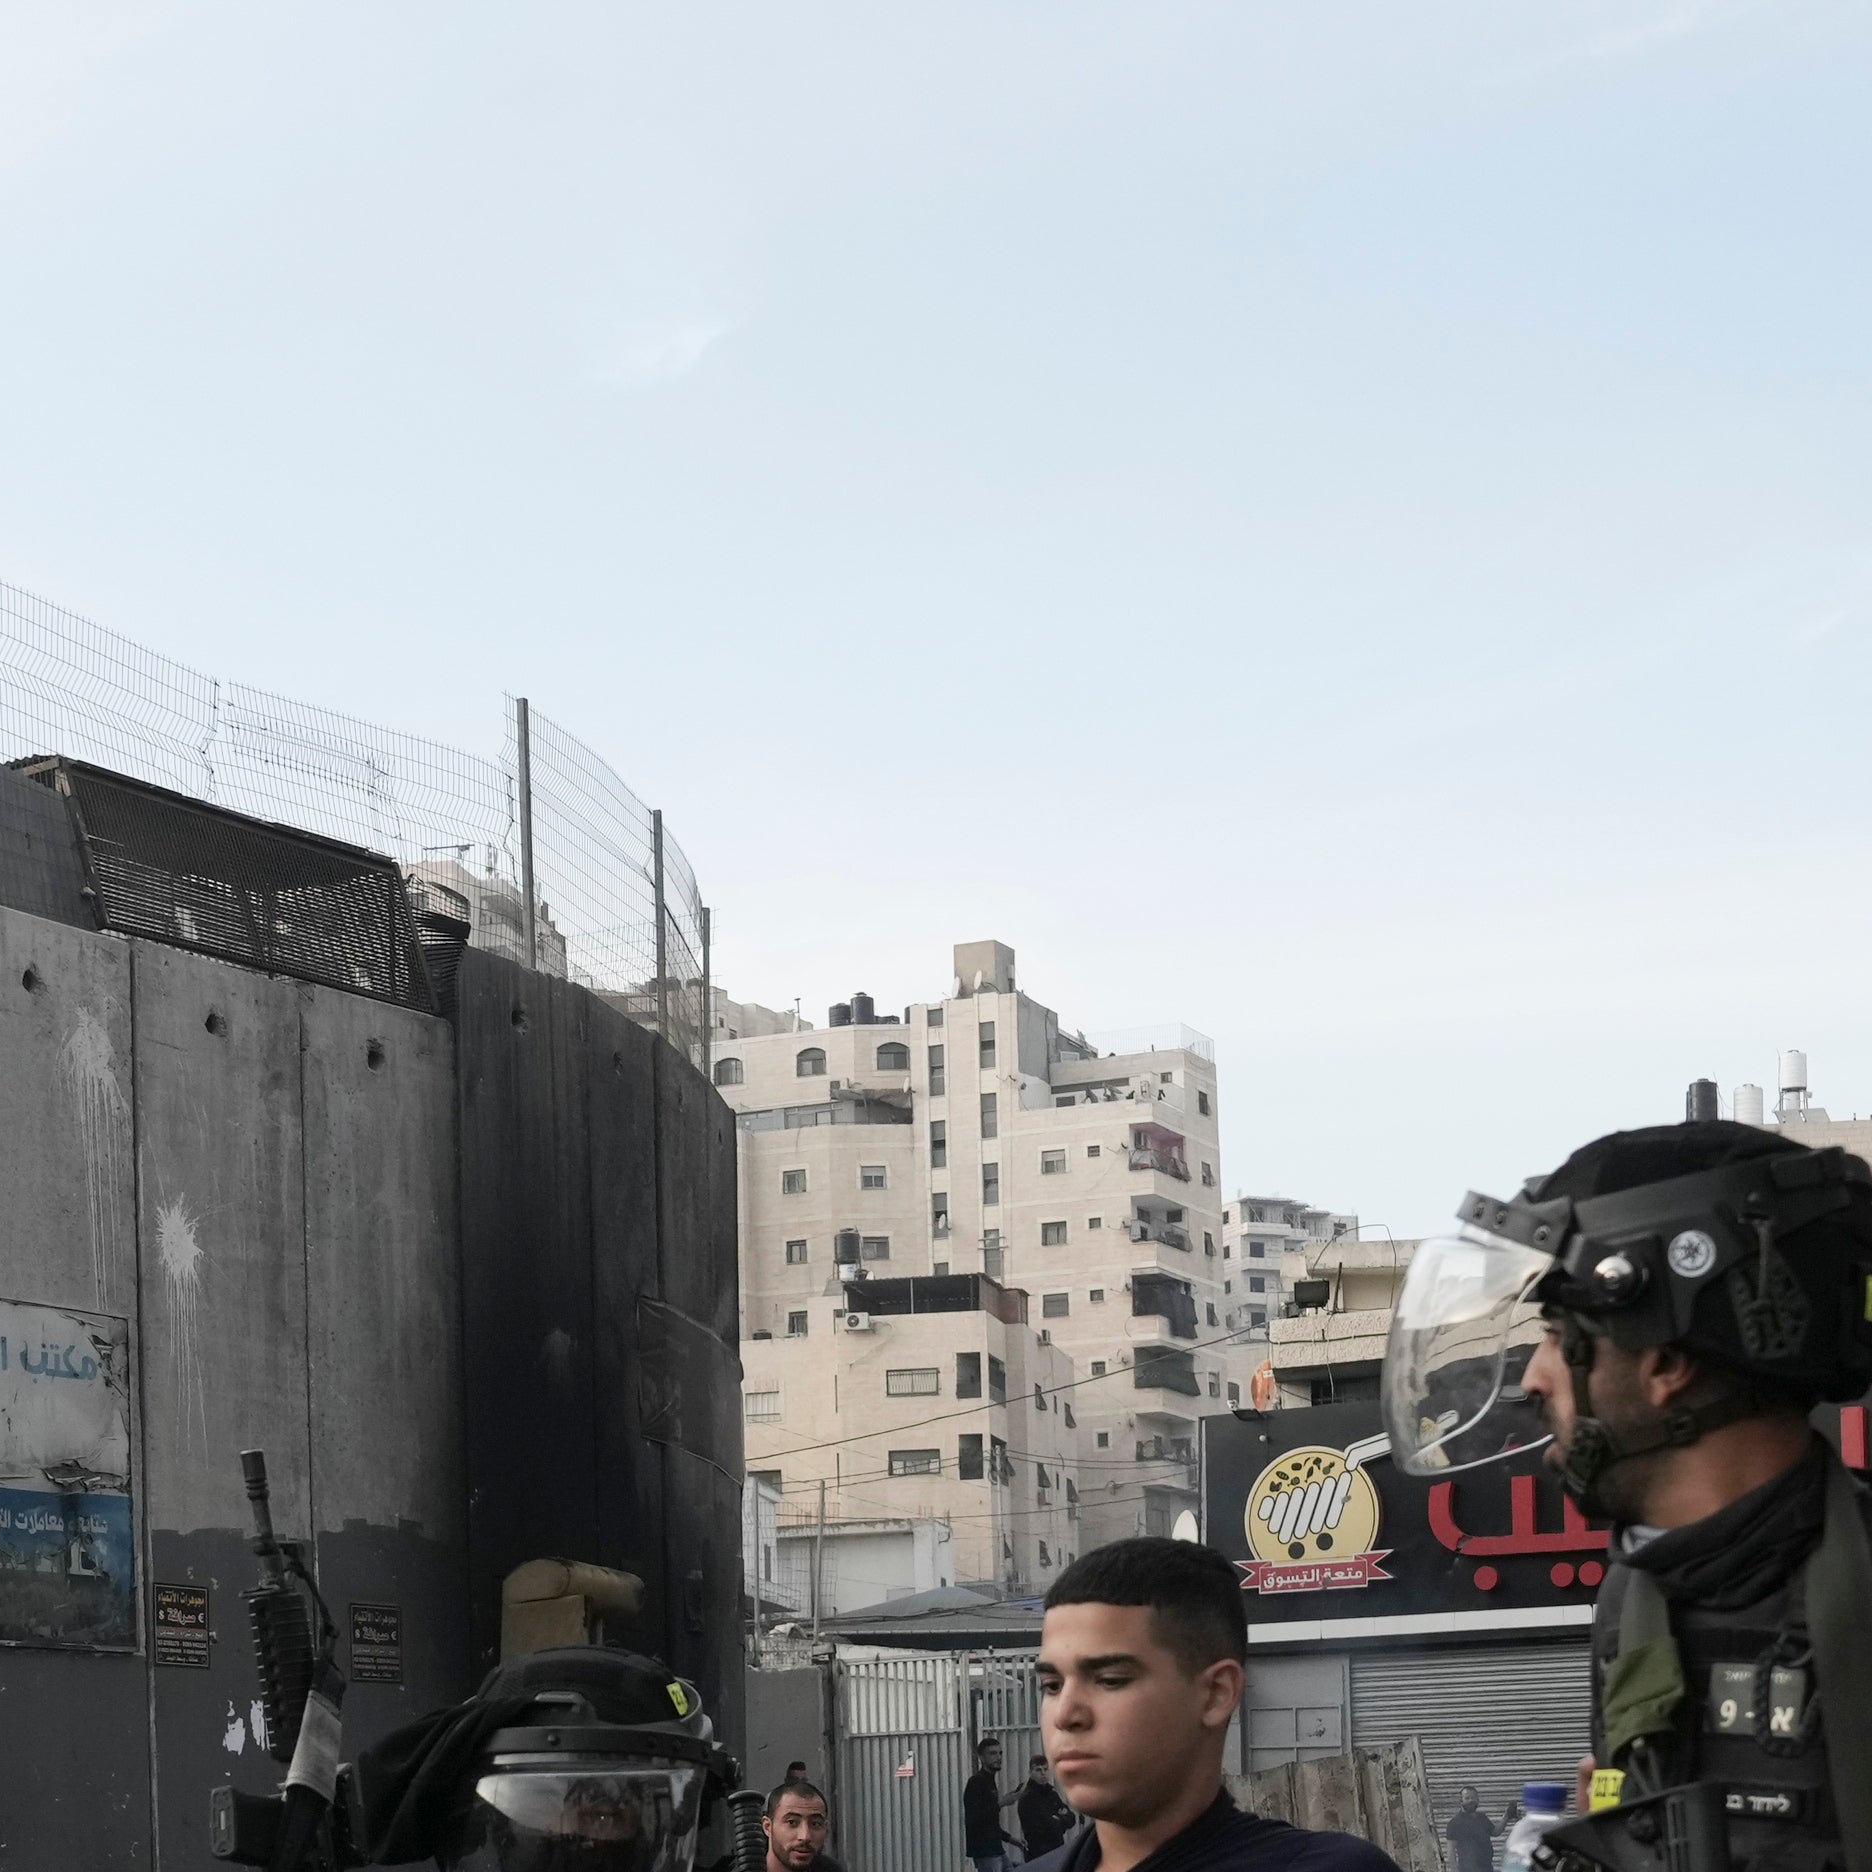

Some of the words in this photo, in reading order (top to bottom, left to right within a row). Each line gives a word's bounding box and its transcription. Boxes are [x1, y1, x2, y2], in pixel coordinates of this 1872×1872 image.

[20, 1344, 98, 1383] مكتب
[1263, 1568, 1320, 1589] التسوق
[1323, 1566, 1364, 1582] متعة
